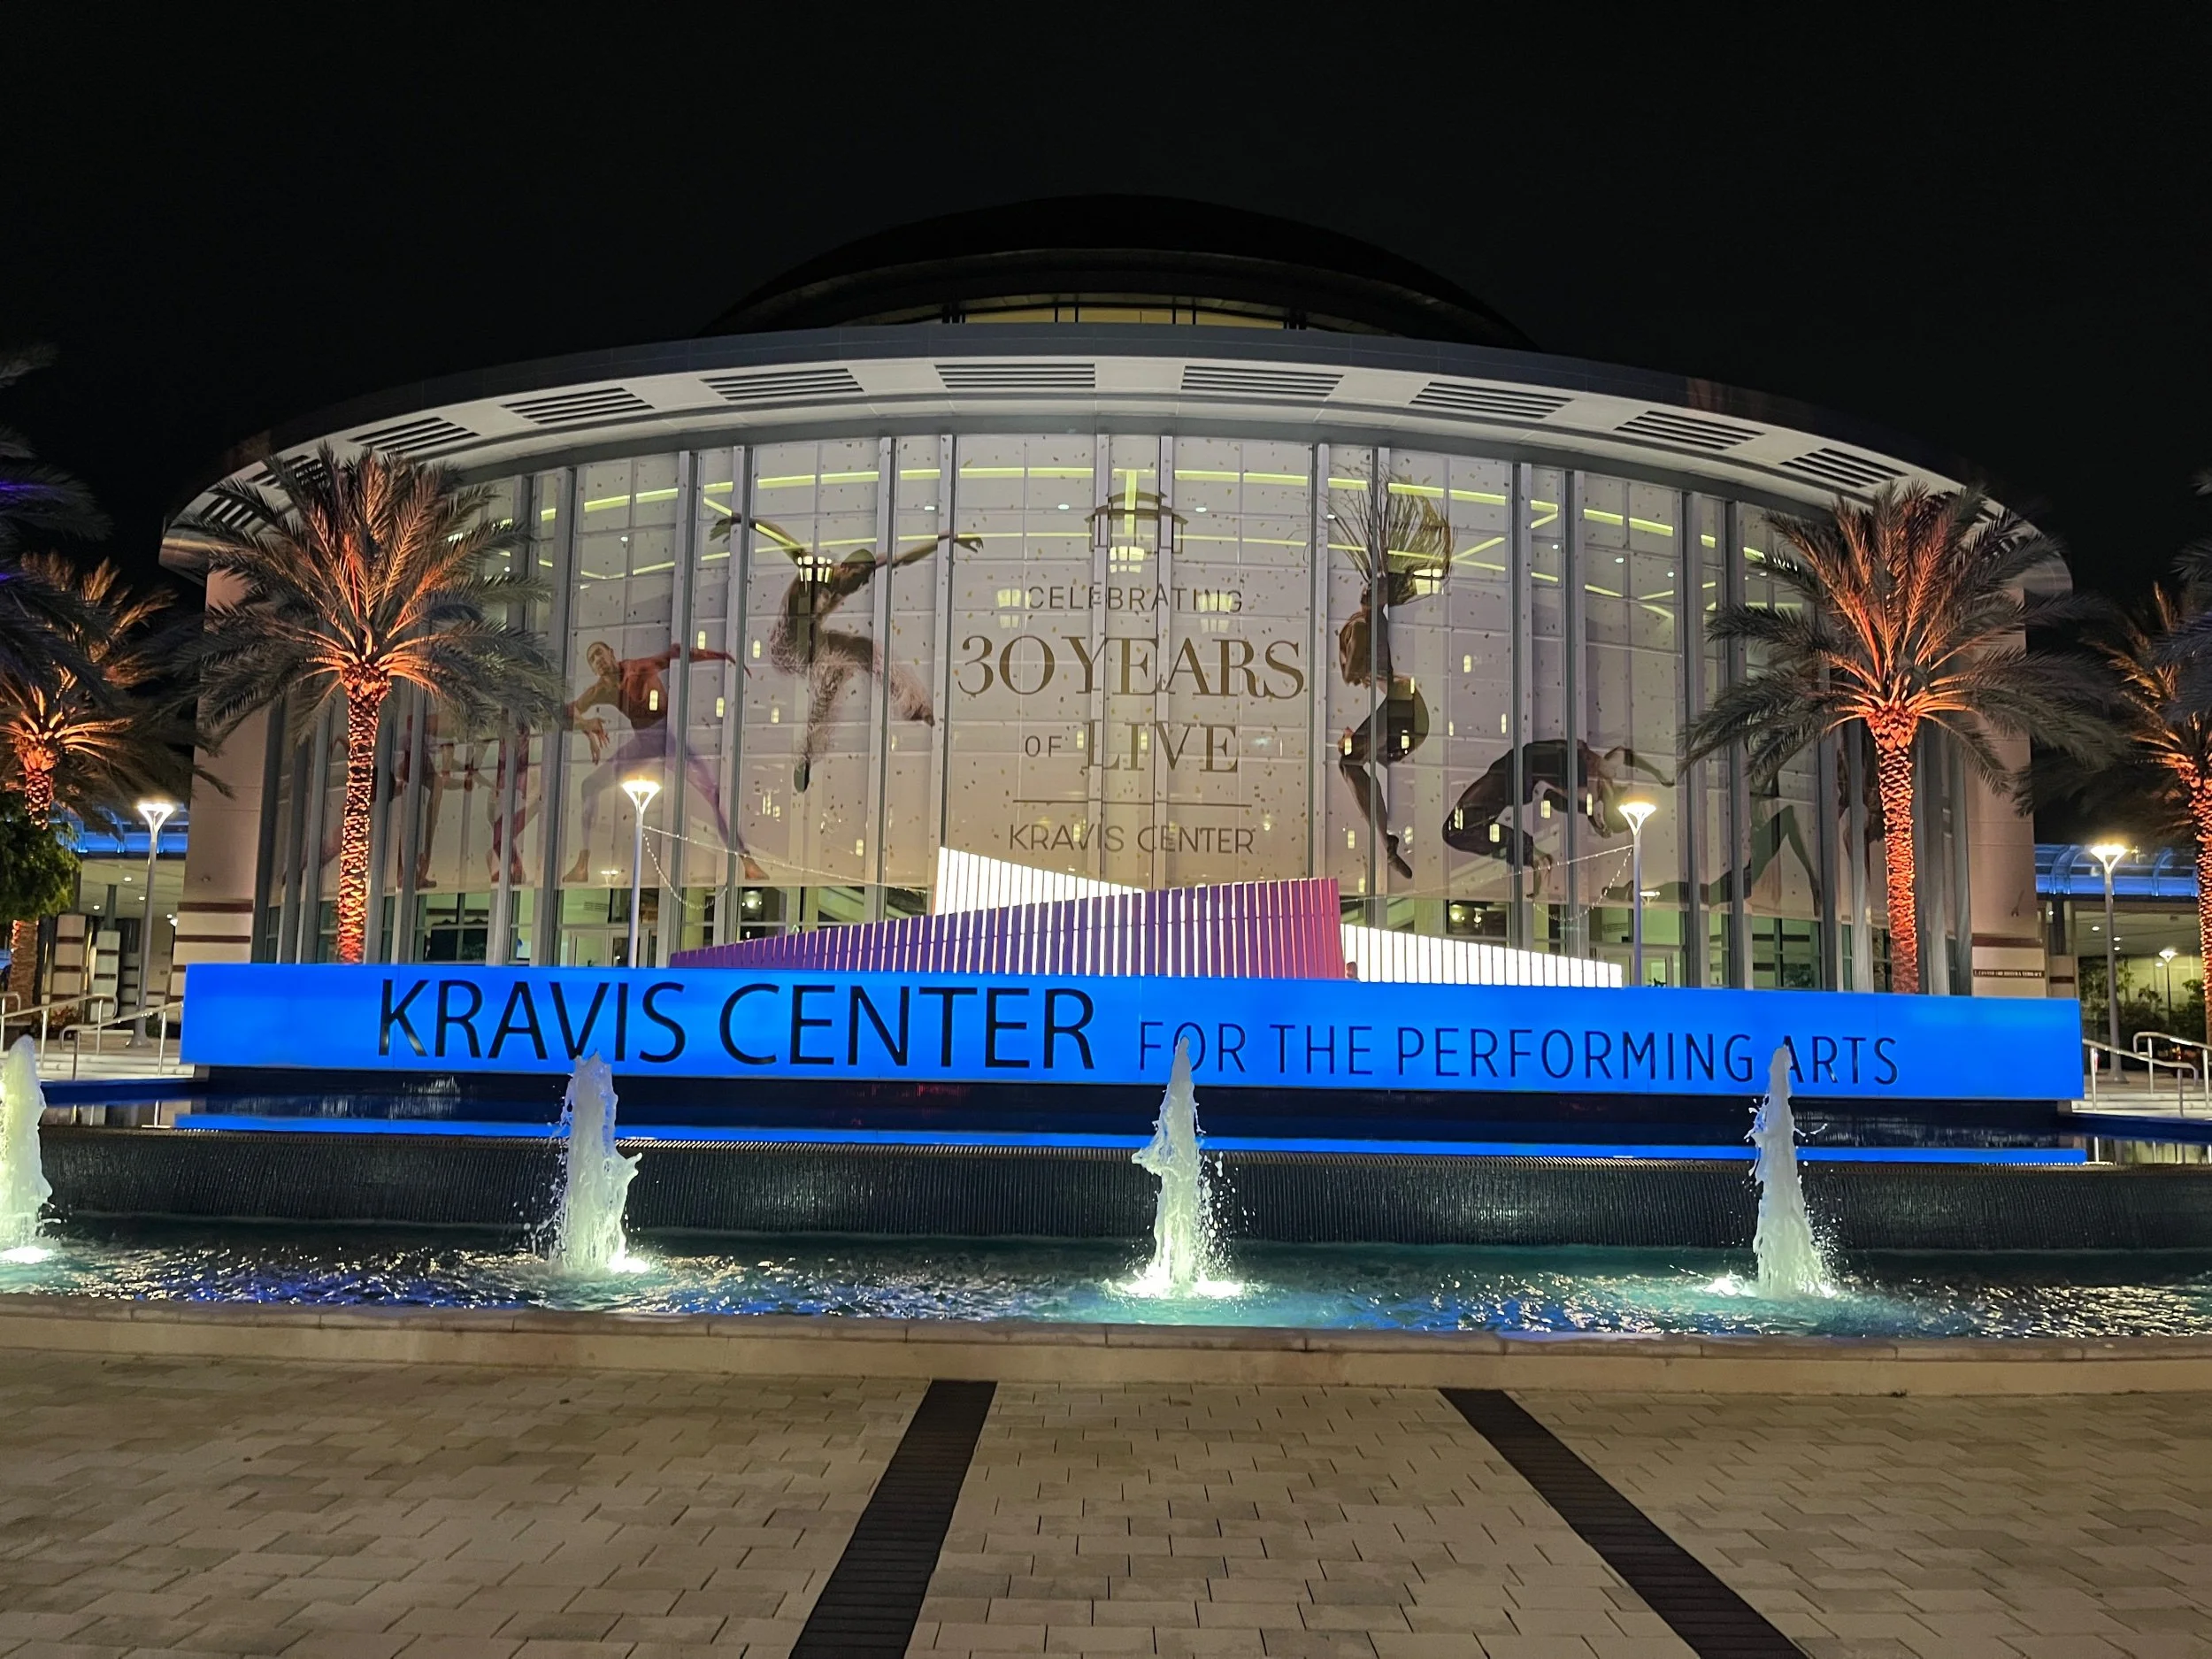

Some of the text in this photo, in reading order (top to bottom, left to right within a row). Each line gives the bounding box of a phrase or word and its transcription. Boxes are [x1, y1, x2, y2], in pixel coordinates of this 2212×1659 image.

[1028, 581, 1243, 615] CELEBRATING
[1025, 719, 1239, 773] OF LIVE
[1010, 823, 1255, 855] KRAVIS CENTER
[378, 979, 686, 1064] KRAVIS
[718, 982, 1095, 1071] CENTER
[1139, 1021, 1246, 1073] FOR
[1269, 1024, 1373, 1075] THE
[1397, 1026, 1754, 1083] PERFORMING
